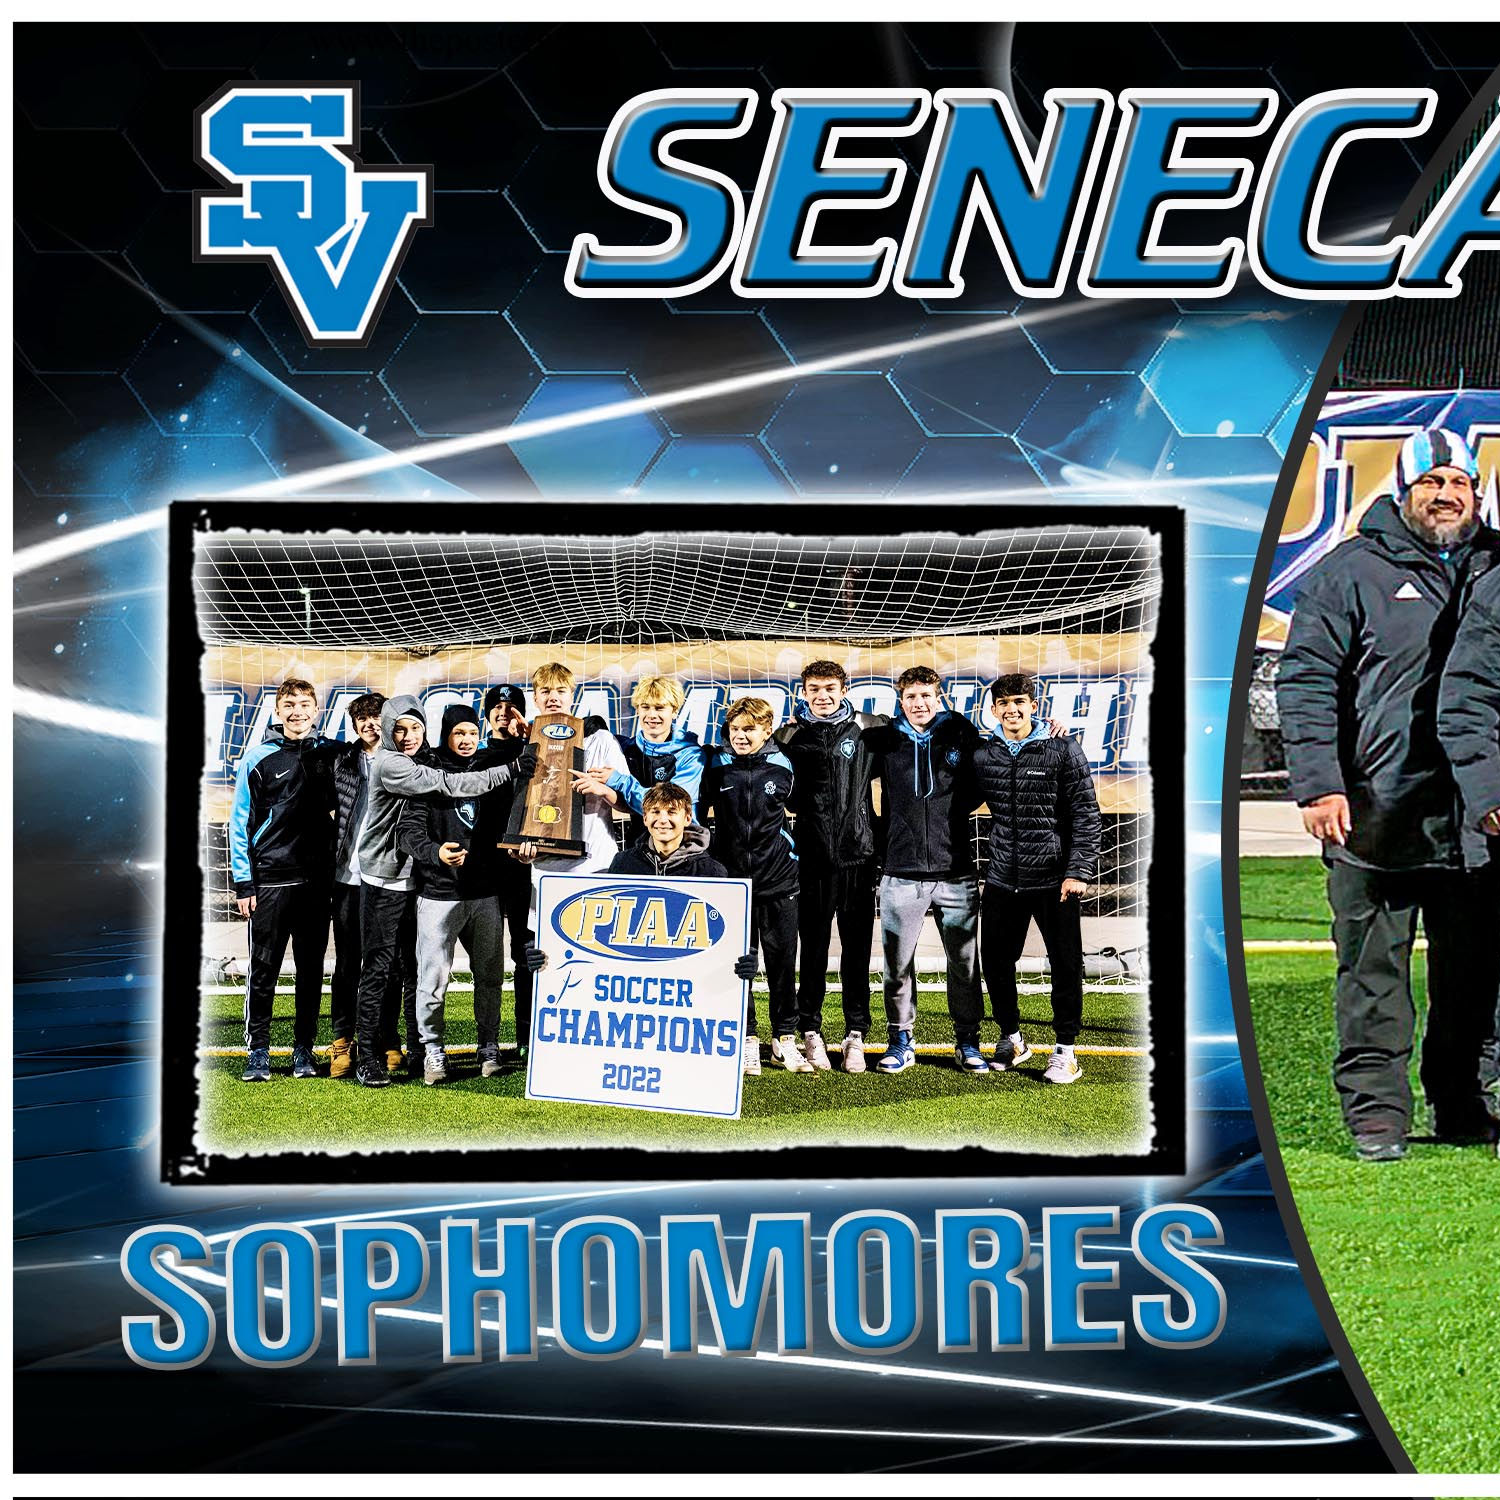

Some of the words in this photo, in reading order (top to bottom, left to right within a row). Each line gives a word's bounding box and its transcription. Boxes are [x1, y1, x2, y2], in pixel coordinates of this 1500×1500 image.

[576, 895, 713, 949] PIAA
[594, 974, 693, 1007] SOCCER
[538, 1006, 738, 1057] CHAMPIONS
[602, 1063, 662, 1093] 2022
